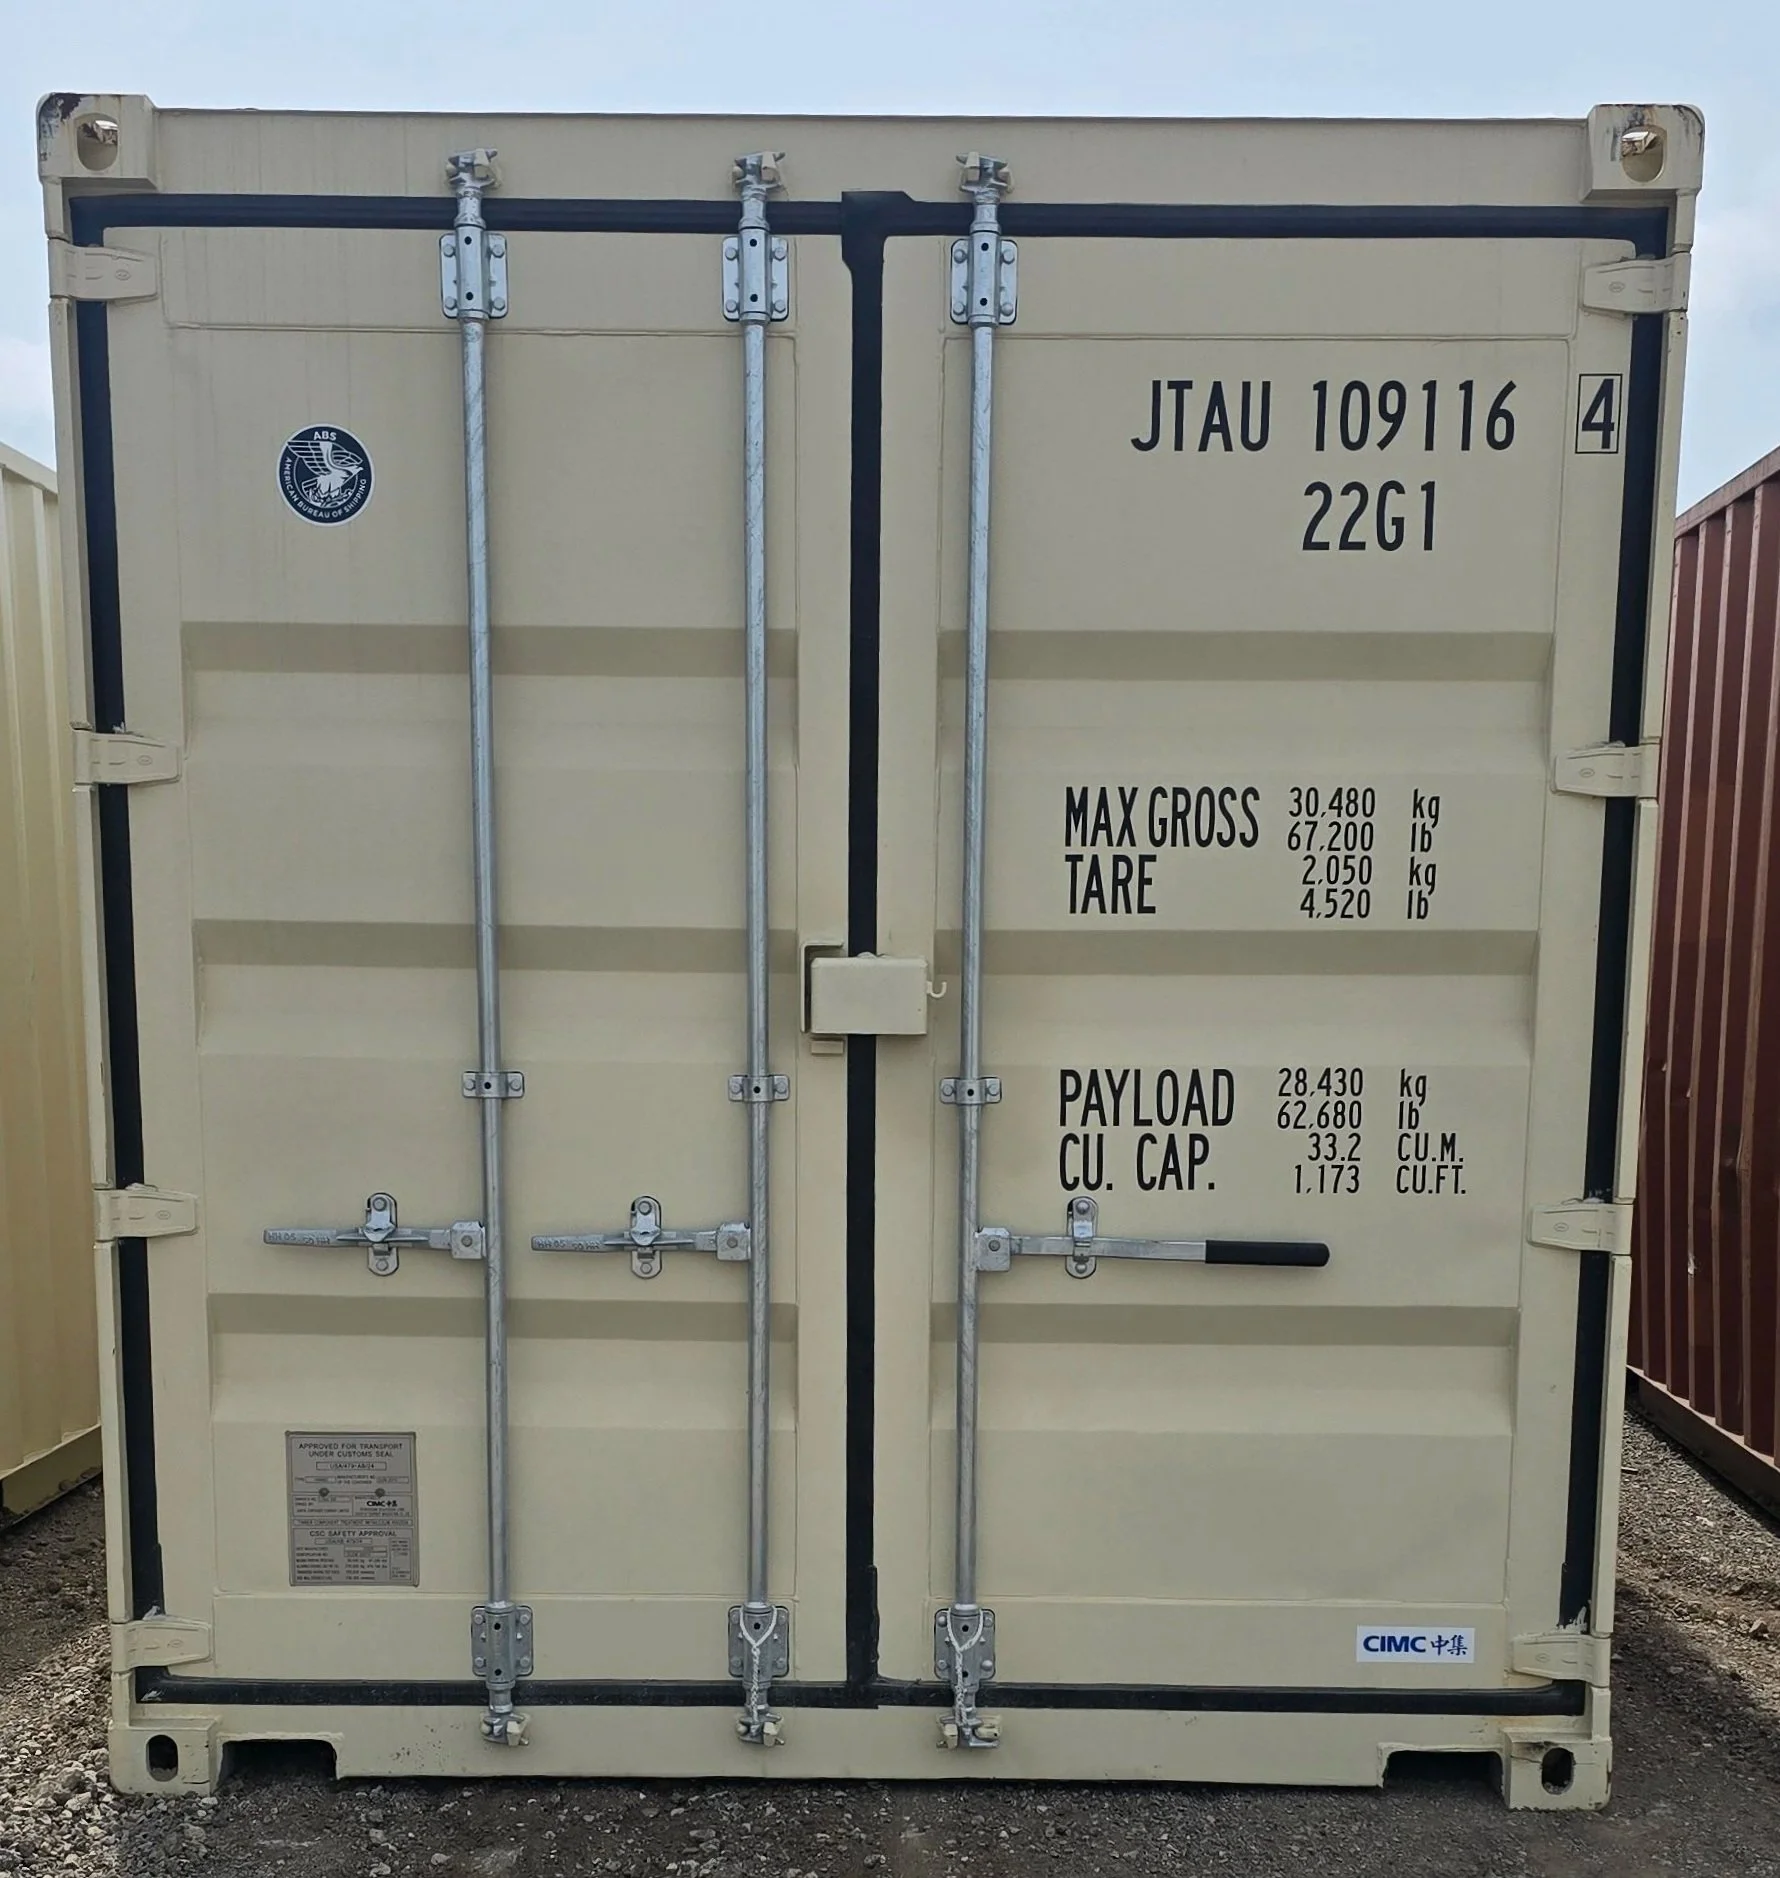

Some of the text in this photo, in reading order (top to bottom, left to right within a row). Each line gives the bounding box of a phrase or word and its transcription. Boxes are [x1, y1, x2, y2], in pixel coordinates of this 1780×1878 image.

[313, 430, 337, 441] ABS
[1130, 378, 1616, 453] JTAU 109116 4
[283, 456, 367, 519] AMERICAN BUREAU OF SHIPPING
[1302, 479, 1436, 552] 22G1
[1064, 785, 1260, 848] MAX GROSS
[1288, 786, 1441, 829] 30,480 kg
[1287, 820, 1433, 853] 67,200 lb
[1064, 854, 1157, 915] TARE
[1301, 854, 1437, 896] 2,050 kg
[1299, 887, 1430, 920] 4,520 lb
[1059, 1068, 1235, 1127] PAYLOAD
[1278, 1067, 1427, 1107] 28,430 kg
[1277, 1100, 1420, 1131] 62,680 lb
[1059, 1132, 1215, 1192] CU. CAP.
[1307, 1132, 1464, 1163] 33.2 CU.M.
[1294, 1163, 1466, 1195] 1,173 CU.FT.
[308, 1450, 393, 1458] UNDER CUSTOMS SEAL
[309, 1530, 398, 1538] CSC SAFETY APPROVAL
[1363, 1634, 1468, 1656] CIMC 中集
